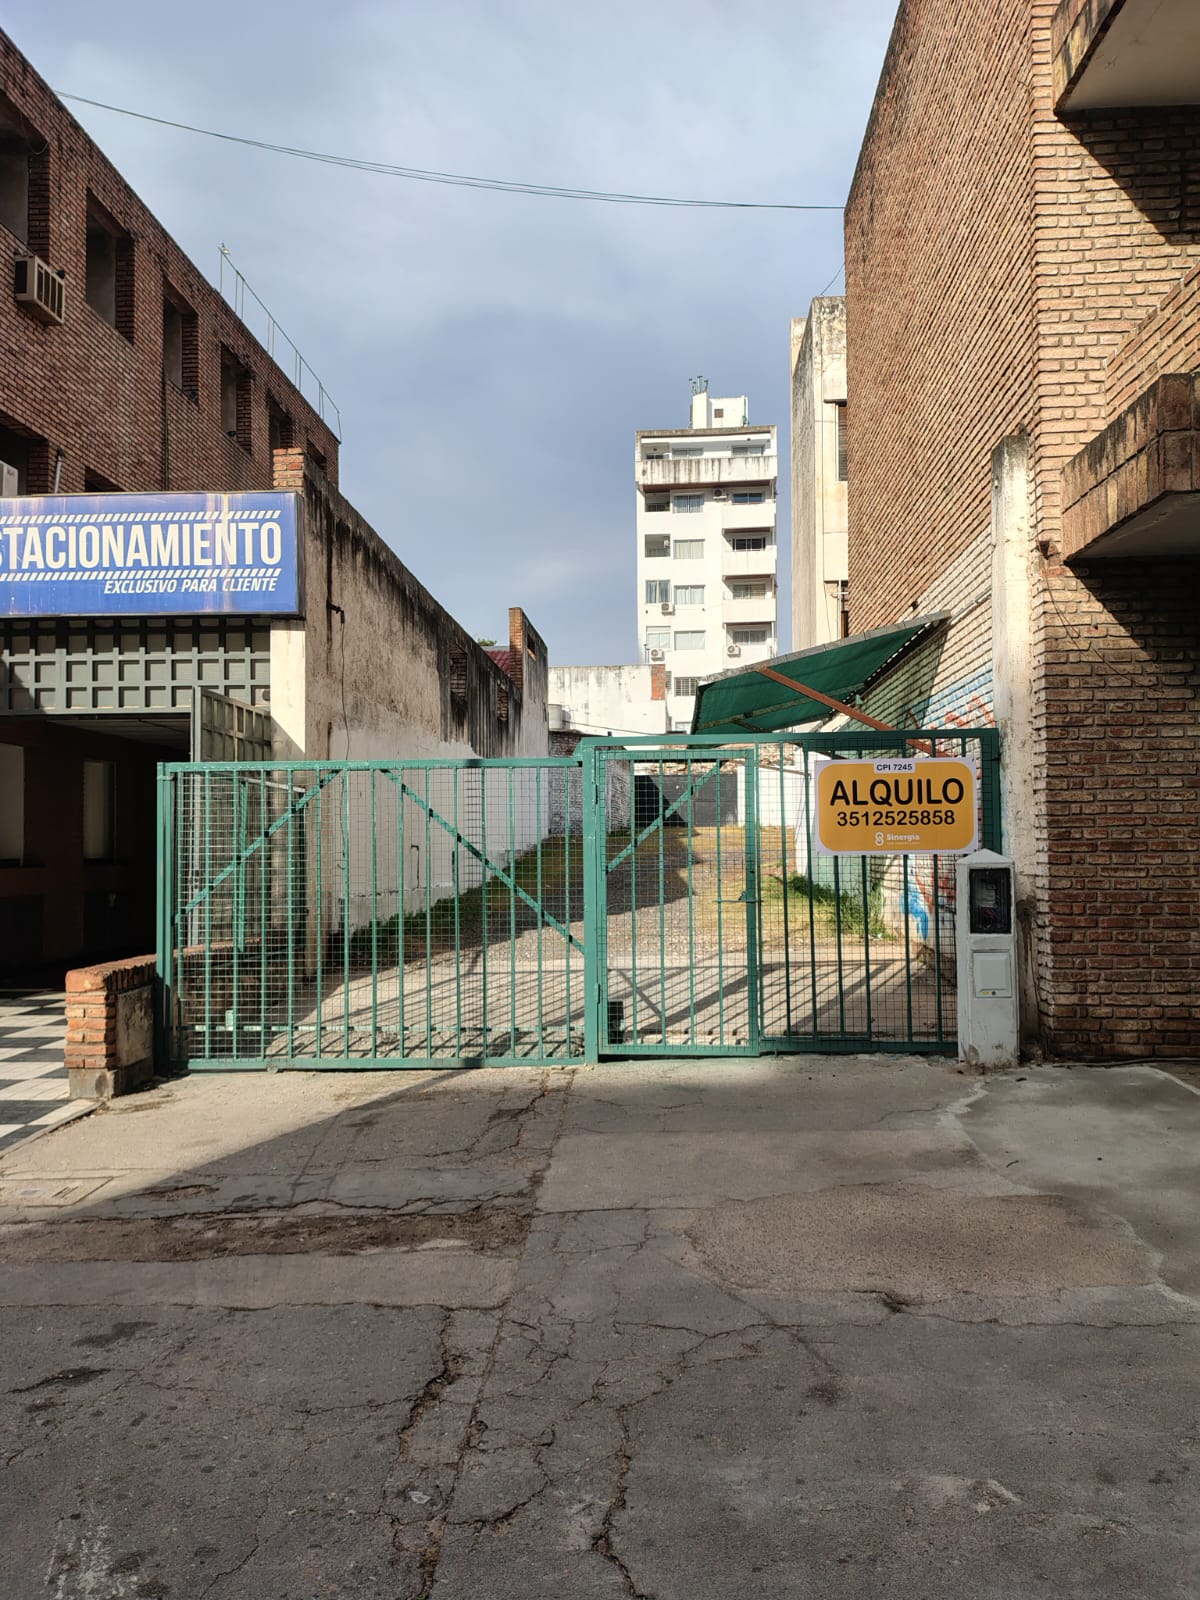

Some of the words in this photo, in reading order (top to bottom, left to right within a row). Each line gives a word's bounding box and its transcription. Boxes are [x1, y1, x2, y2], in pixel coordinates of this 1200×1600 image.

[0, 521, 282, 570] TACIONAMIENTO
[104, 579, 177, 594] EXCLUSIVO
[181, 578, 217, 593] PARA
[222, 577, 278, 592] CLIENTE
[893, 763, 913, 771] 7245
[830, 778, 964, 807] ALQUILO
[837, 810, 955, 826] 3512525858
